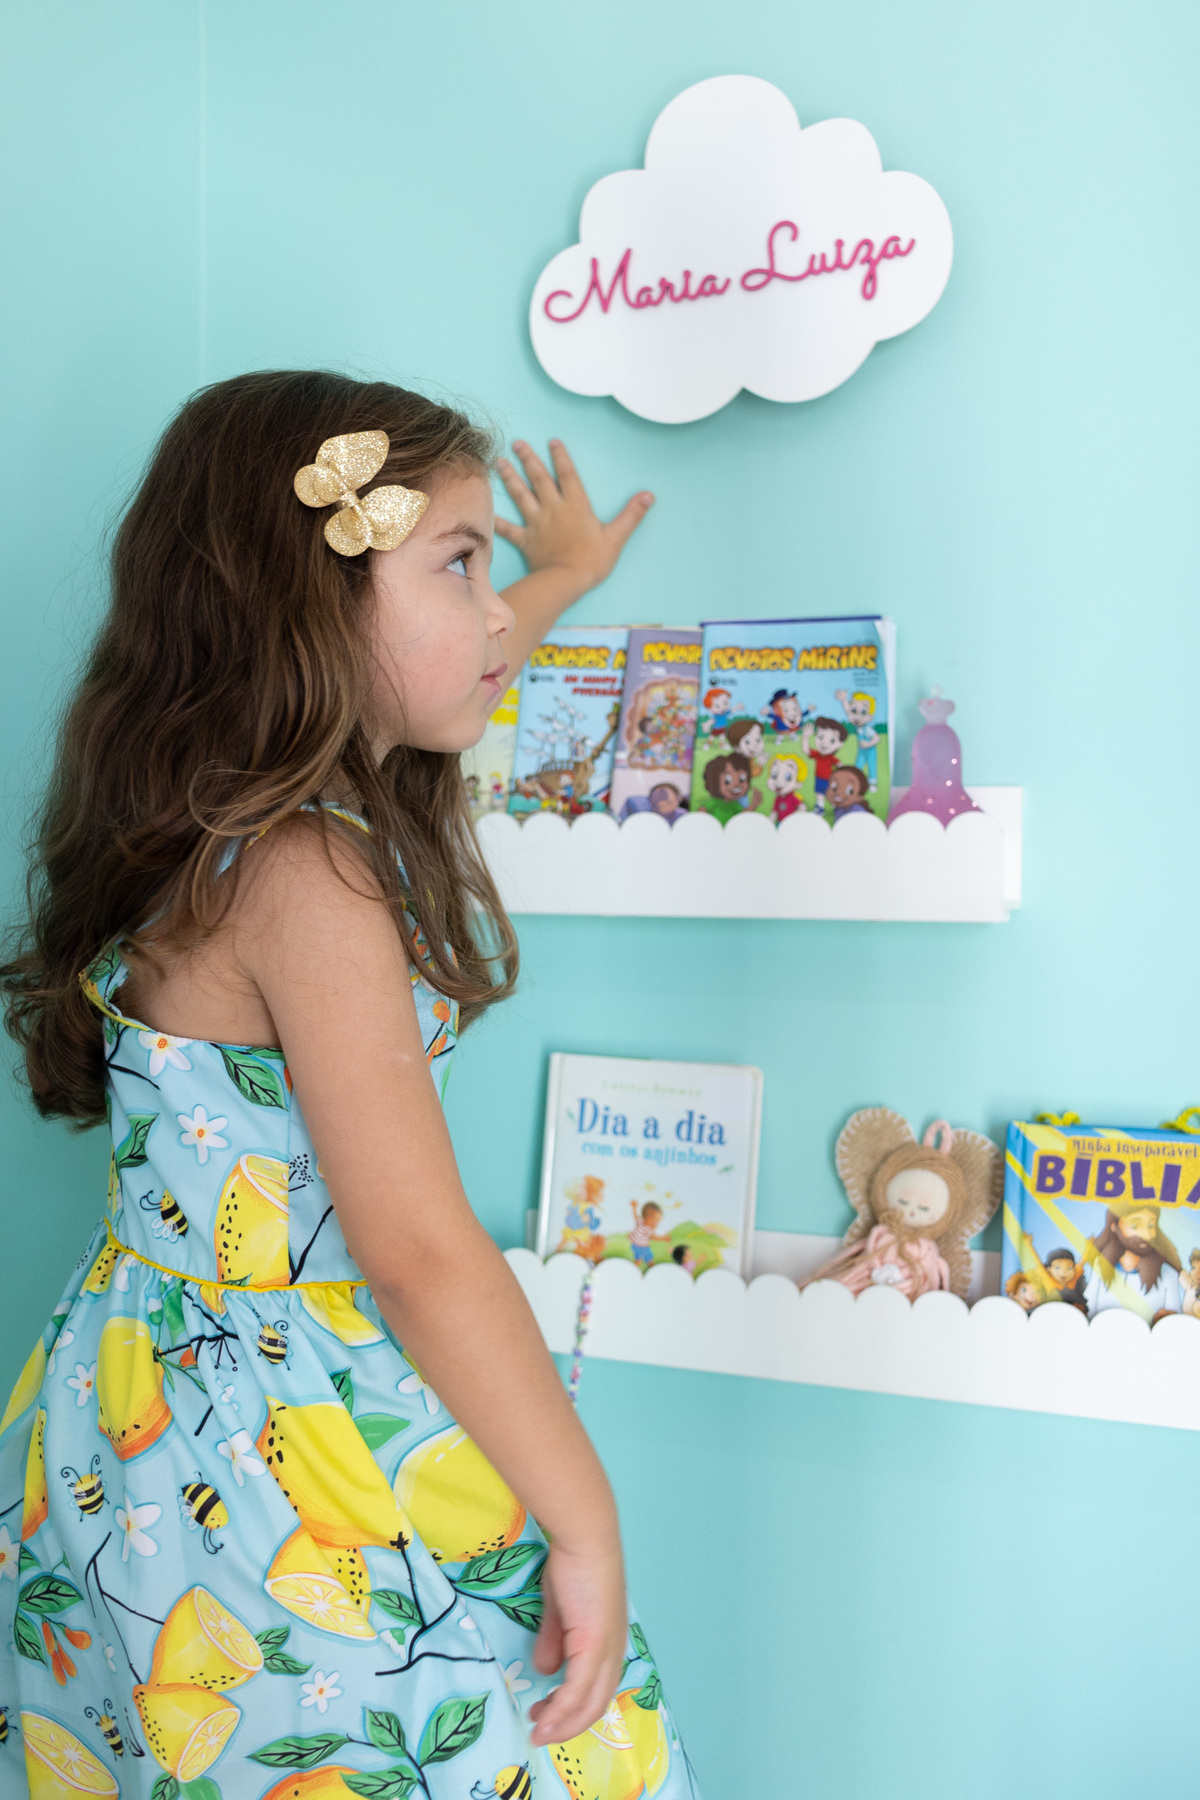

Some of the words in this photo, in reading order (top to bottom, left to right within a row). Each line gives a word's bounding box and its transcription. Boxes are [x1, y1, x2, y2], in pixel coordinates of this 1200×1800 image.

[543, 247, 731, 323] Maria
[739, 220, 916, 301] Luiza
[709, 647, 796, 671] DEVOTOS
[577, 1097, 629, 1137] Dia
[643, 1115, 661, 1139] a
[675, 1110, 726, 1146] dia
[581, 1141, 614, 1157] com
[619, 1144, 638, 1159] os
[643, 1146, 718, 1166] anjinhos
[1072, 1139, 1112, 1153] Minha
[1116, 1142, 1198, 1158] inseparável
